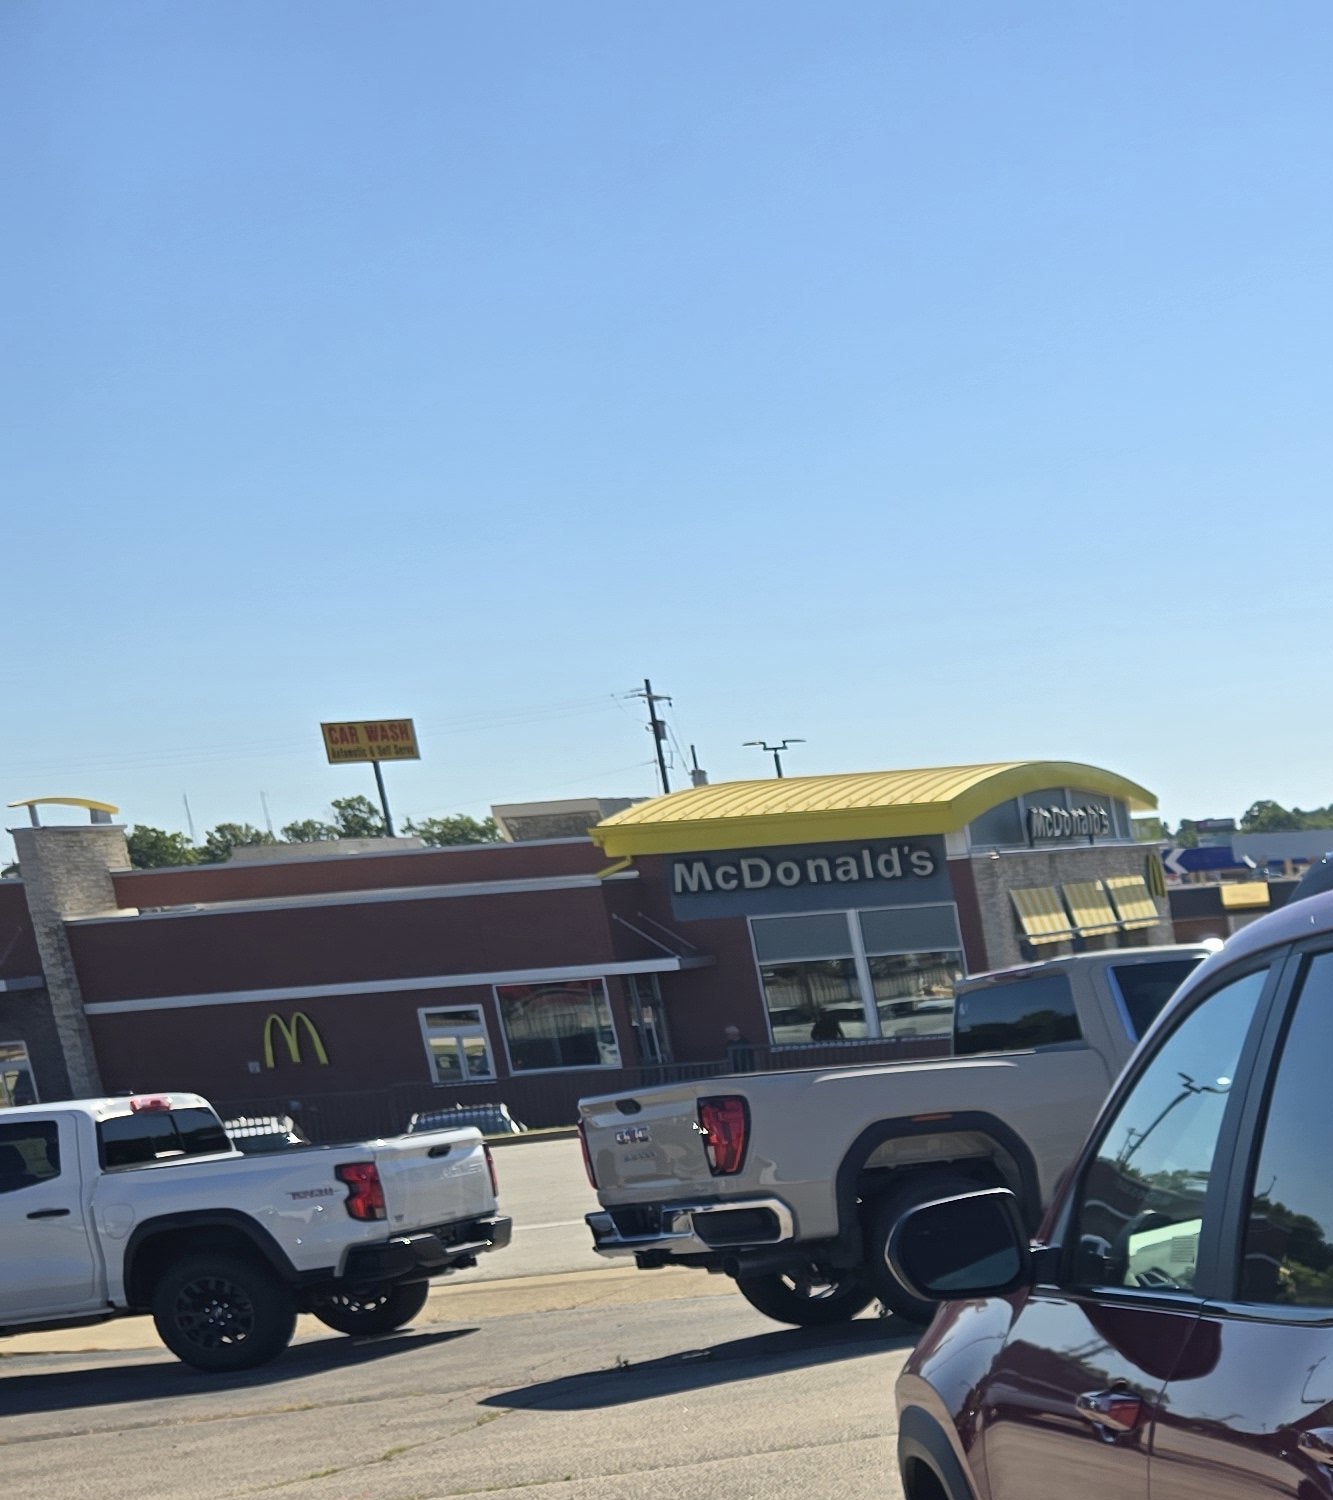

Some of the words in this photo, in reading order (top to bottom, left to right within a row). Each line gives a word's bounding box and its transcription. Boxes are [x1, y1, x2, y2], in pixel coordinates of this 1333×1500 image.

[327, 726, 359, 745] CAR
[364, 723, 411, 742] WASH
[673, 846, 935, 893] McDonald's
